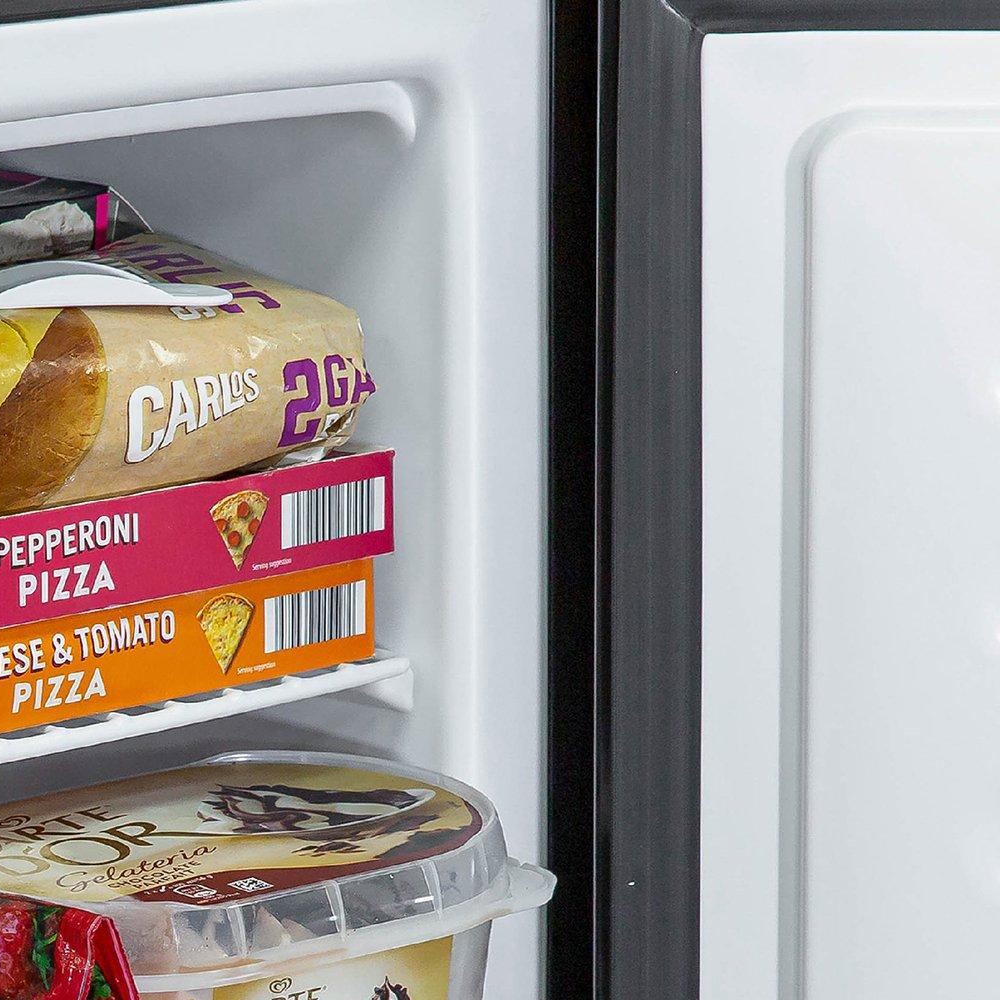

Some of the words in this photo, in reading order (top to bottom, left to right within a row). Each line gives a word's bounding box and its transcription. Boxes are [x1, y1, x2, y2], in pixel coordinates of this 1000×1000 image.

[125, 368, 260, 464] CARLOS
[277, 358, 321, 448] 2
[18, 560, 116, 607] PIZZA
[52, 632, 73, 667] &
[74, 610, 176, 661] TOMATO
[12, 667, 107, 714] PIZZA
[56, 845, 217, 892] Gelateria
[107, 861, 201, 889] CHOCOLATE
